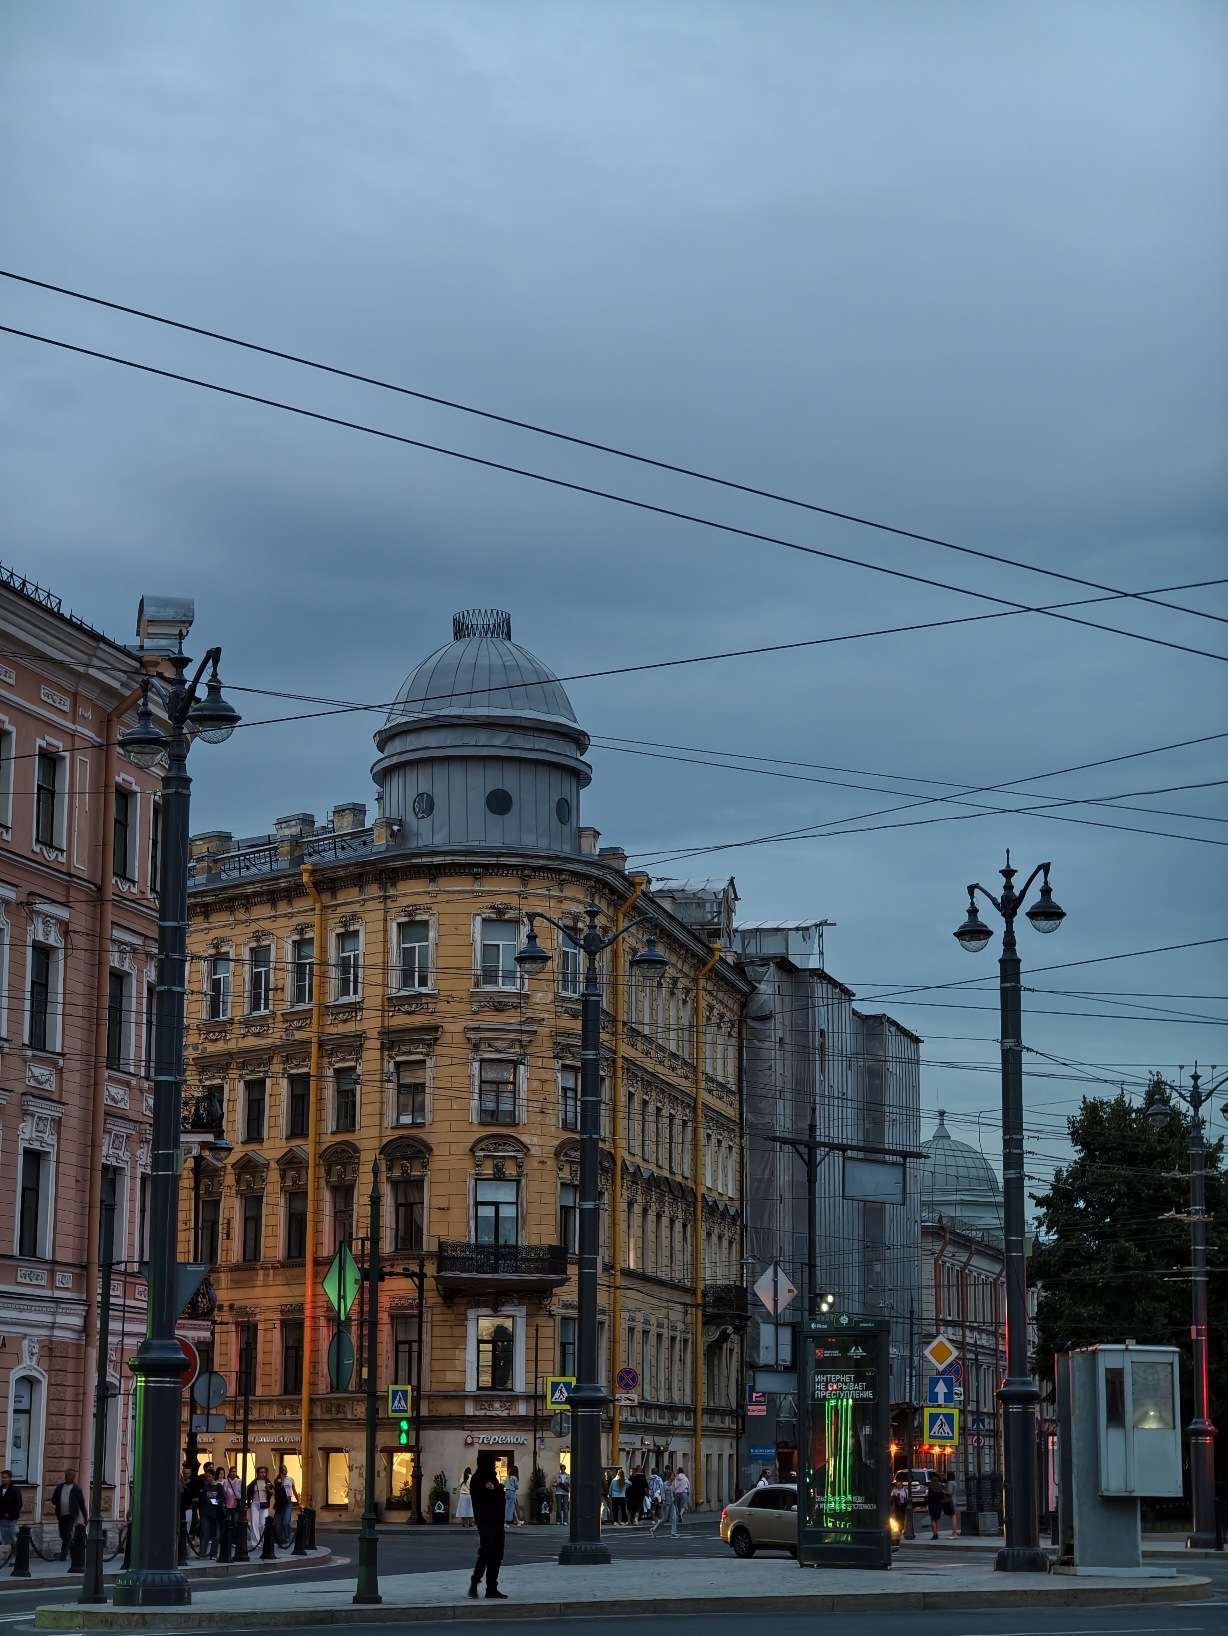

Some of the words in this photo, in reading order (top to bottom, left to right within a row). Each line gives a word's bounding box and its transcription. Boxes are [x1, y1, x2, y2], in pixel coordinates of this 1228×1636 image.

[814, 1374, 855, 1383] ИНТЕРНЕТ
[814, 1382, 826, 1391] НЕ
[827, 1382, 867, 1391] СКРЫВАЕТ
[814, 1390, 874, 1399] ПРЕСТУПЛЕНИЕ
[478, 1434, 528, 1445] теремок
